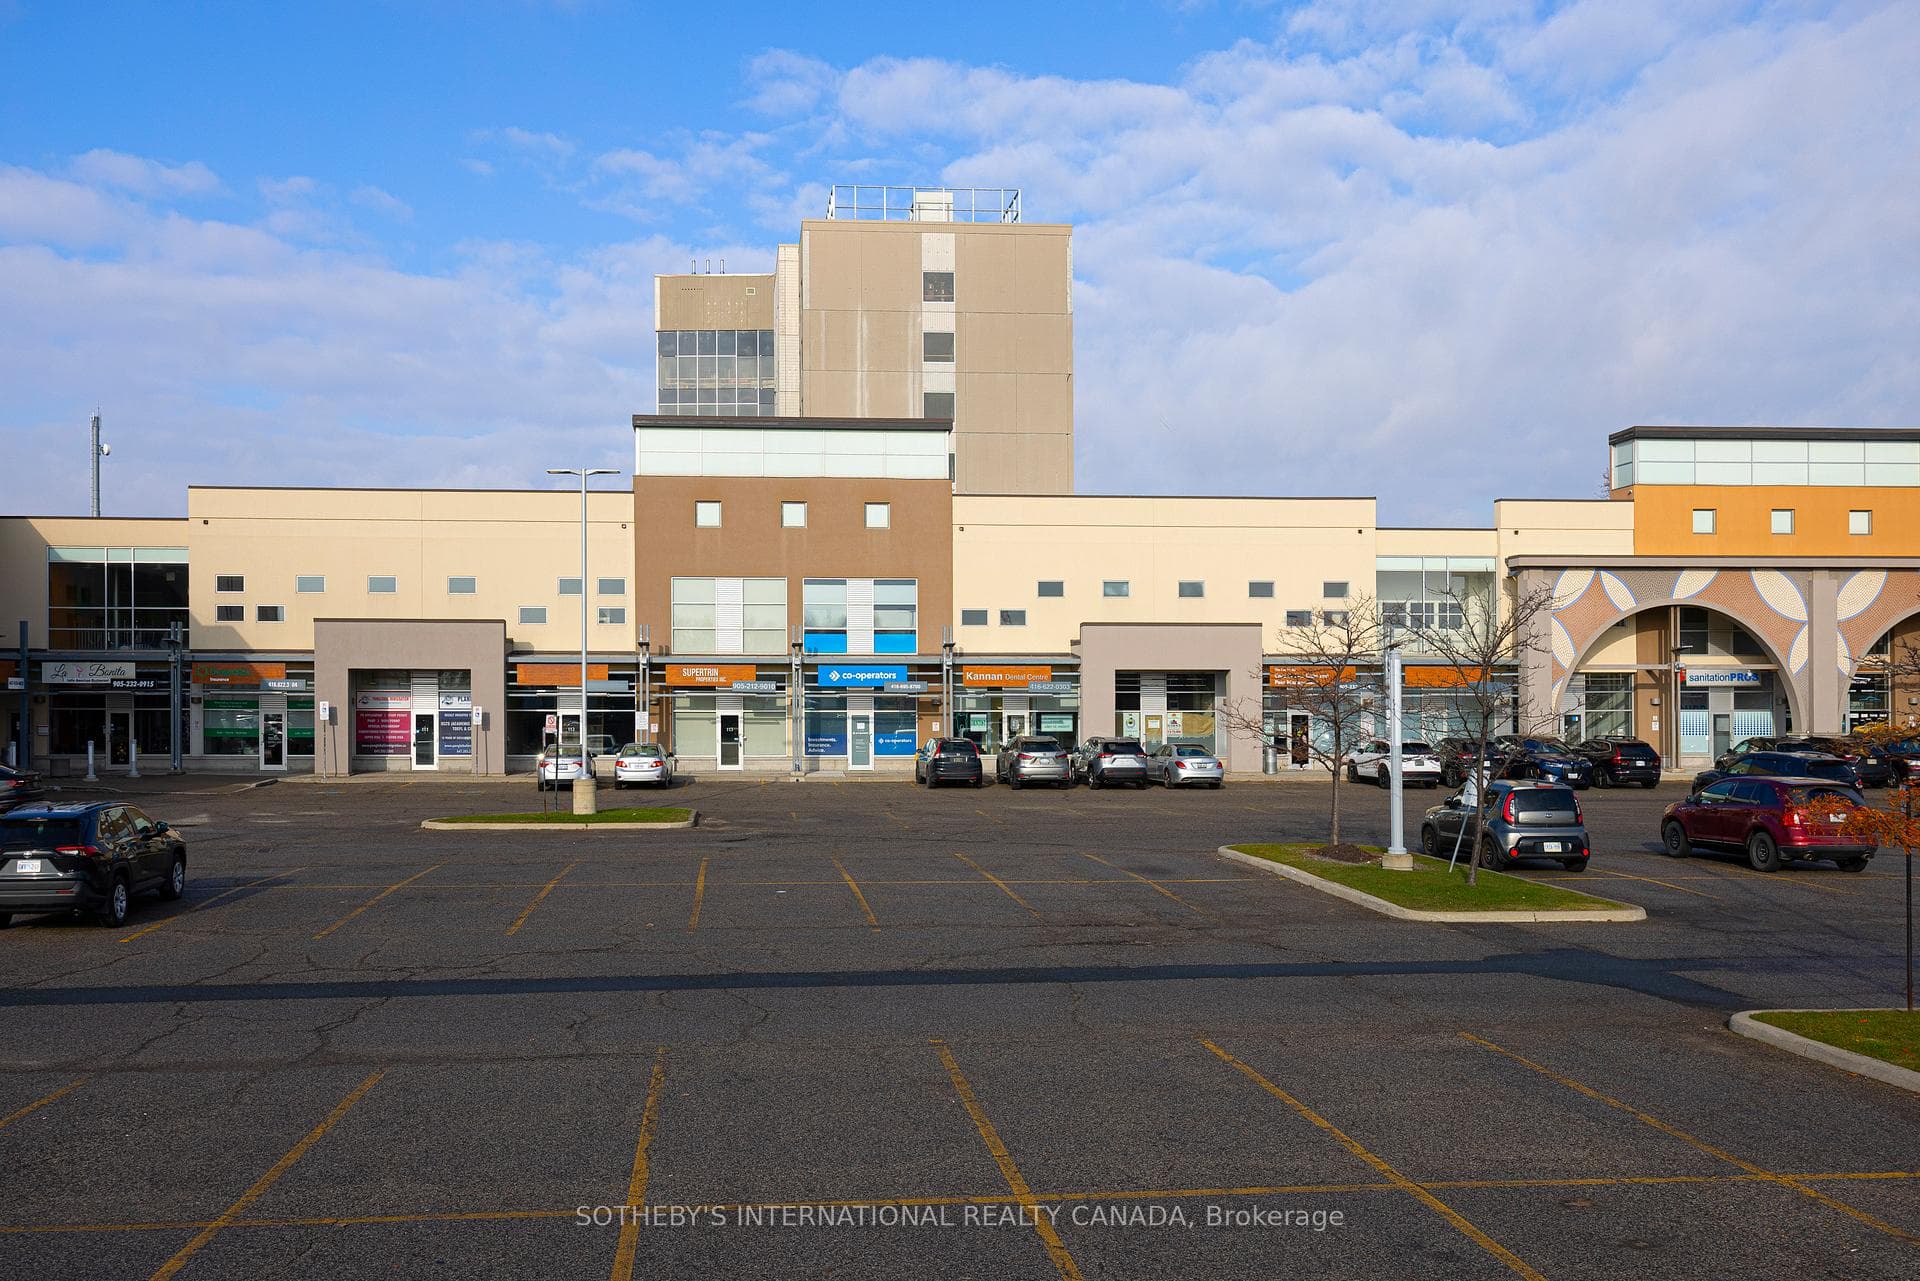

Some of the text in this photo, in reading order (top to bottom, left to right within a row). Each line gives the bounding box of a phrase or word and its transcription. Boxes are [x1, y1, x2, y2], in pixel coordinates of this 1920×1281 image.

[50, 664, 126, 680] La Bonita
[682, 668, 718, 676] SUPERTRIN
[842, 672, 896, 681] co-operators
[966, 672, 1002, 680] Kannan
[1689, 672, 1759, 682] sanitationPROS
